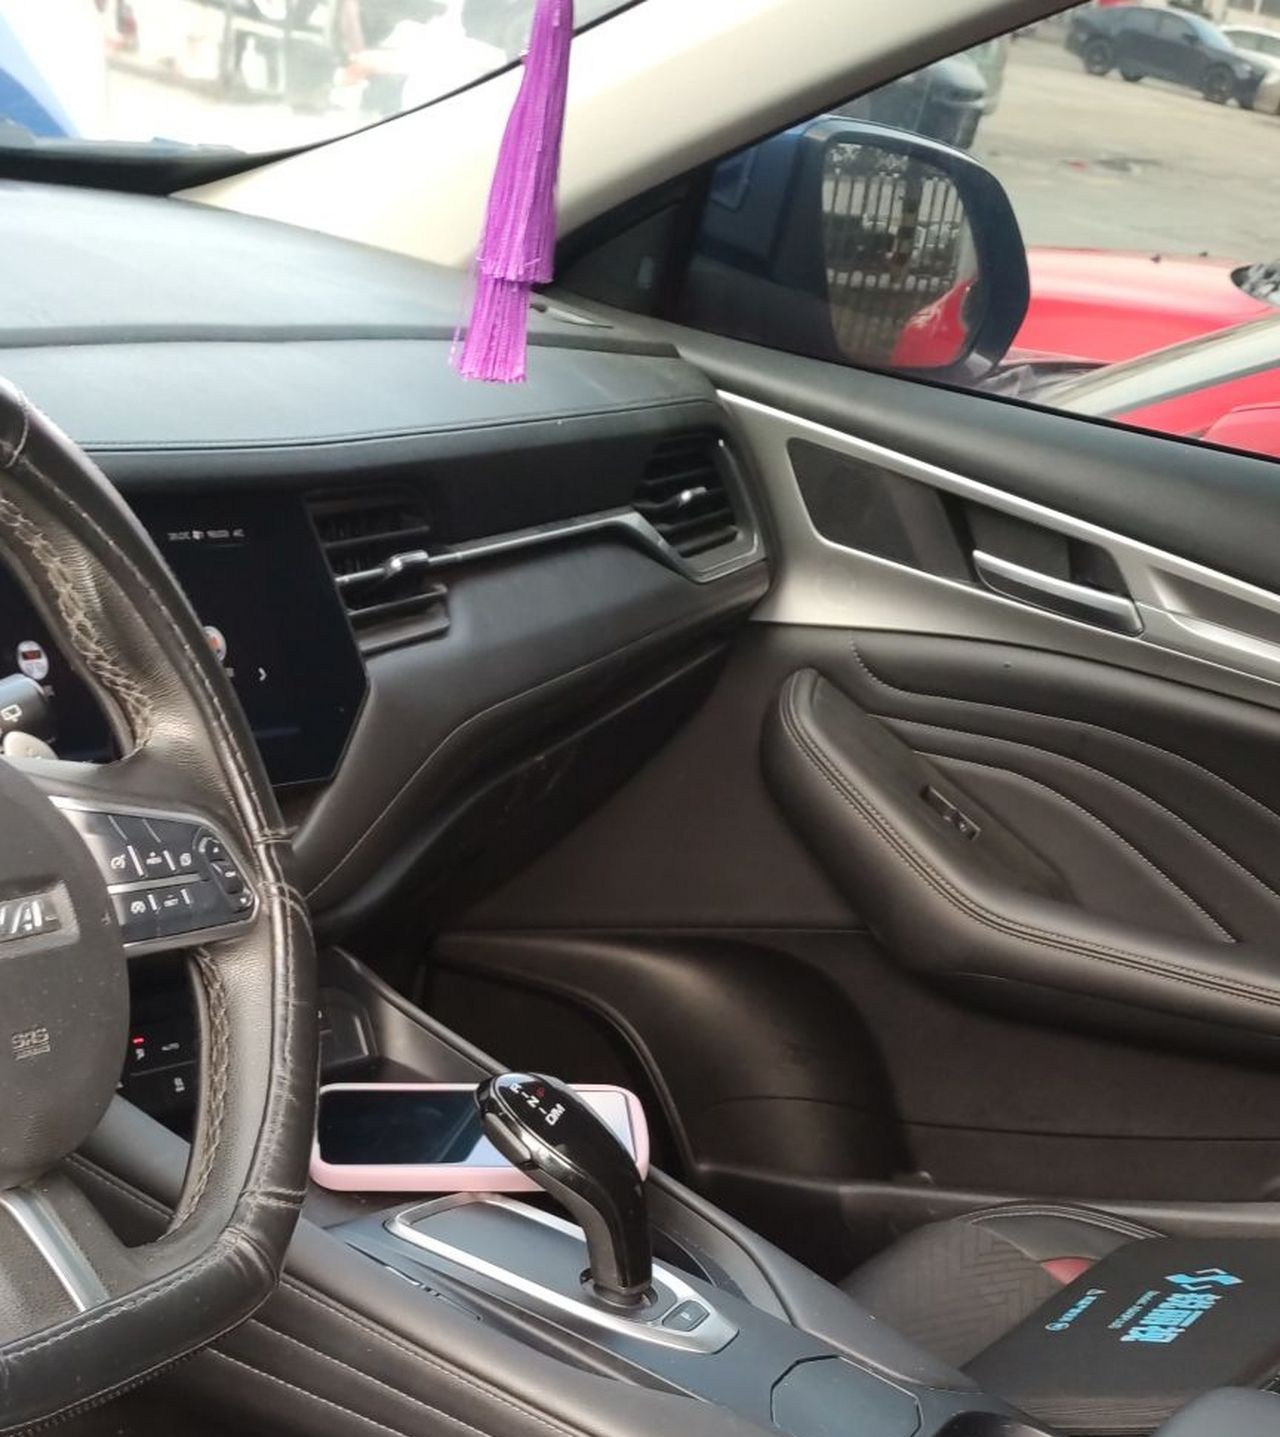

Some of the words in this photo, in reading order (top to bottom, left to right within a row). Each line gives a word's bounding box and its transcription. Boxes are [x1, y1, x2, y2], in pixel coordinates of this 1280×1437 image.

[11, 1028, 49, 1050] SRS
[510, 1082, 522, 1094] R
[526, 1095, 540, 1108] N
